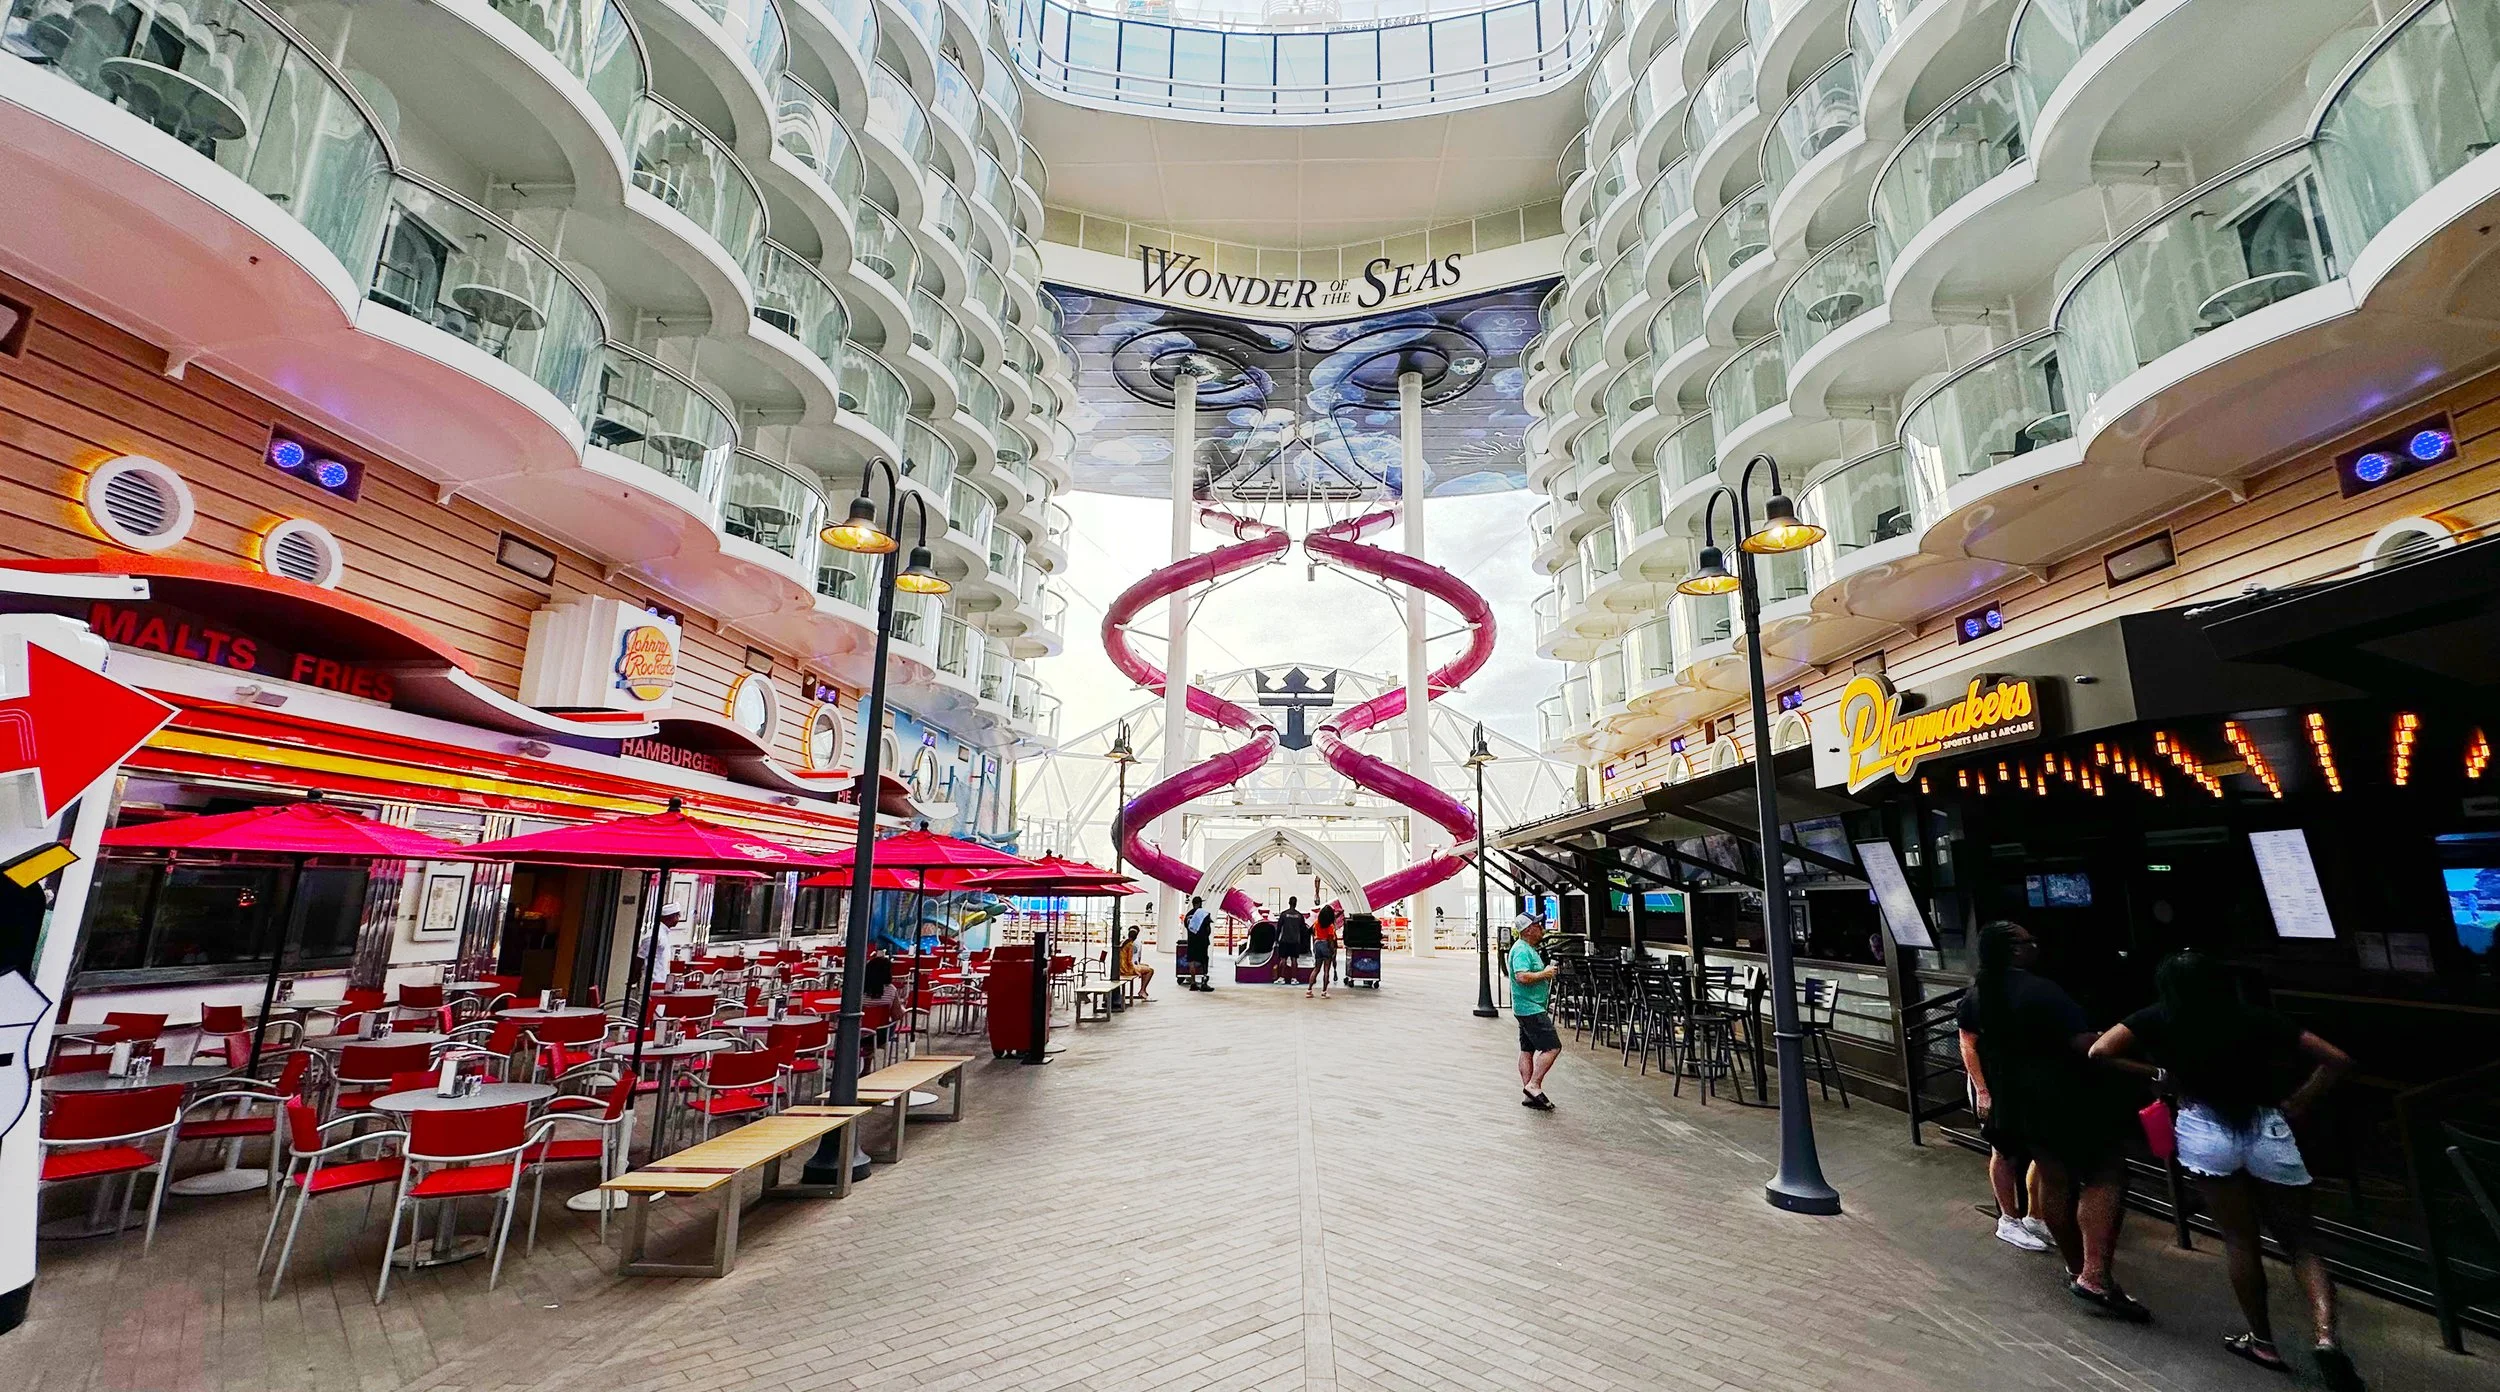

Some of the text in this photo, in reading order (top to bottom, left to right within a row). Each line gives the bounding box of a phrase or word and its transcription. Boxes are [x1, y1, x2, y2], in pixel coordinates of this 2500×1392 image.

[1138, 244, 1461, 308] WONDER OF THE SEAS
[89, 602, 395, 701] MALTS FRIES
[630, 631, 669, 654] Johnny
[625, 653, 675, 677] Rockets
[1840, 677, 2032, 788] Playmakers
[1942, 721, 2035, 749] SPORTS BAR & ARCADE
[622, 738, 728, 775] HAMBURGERS
